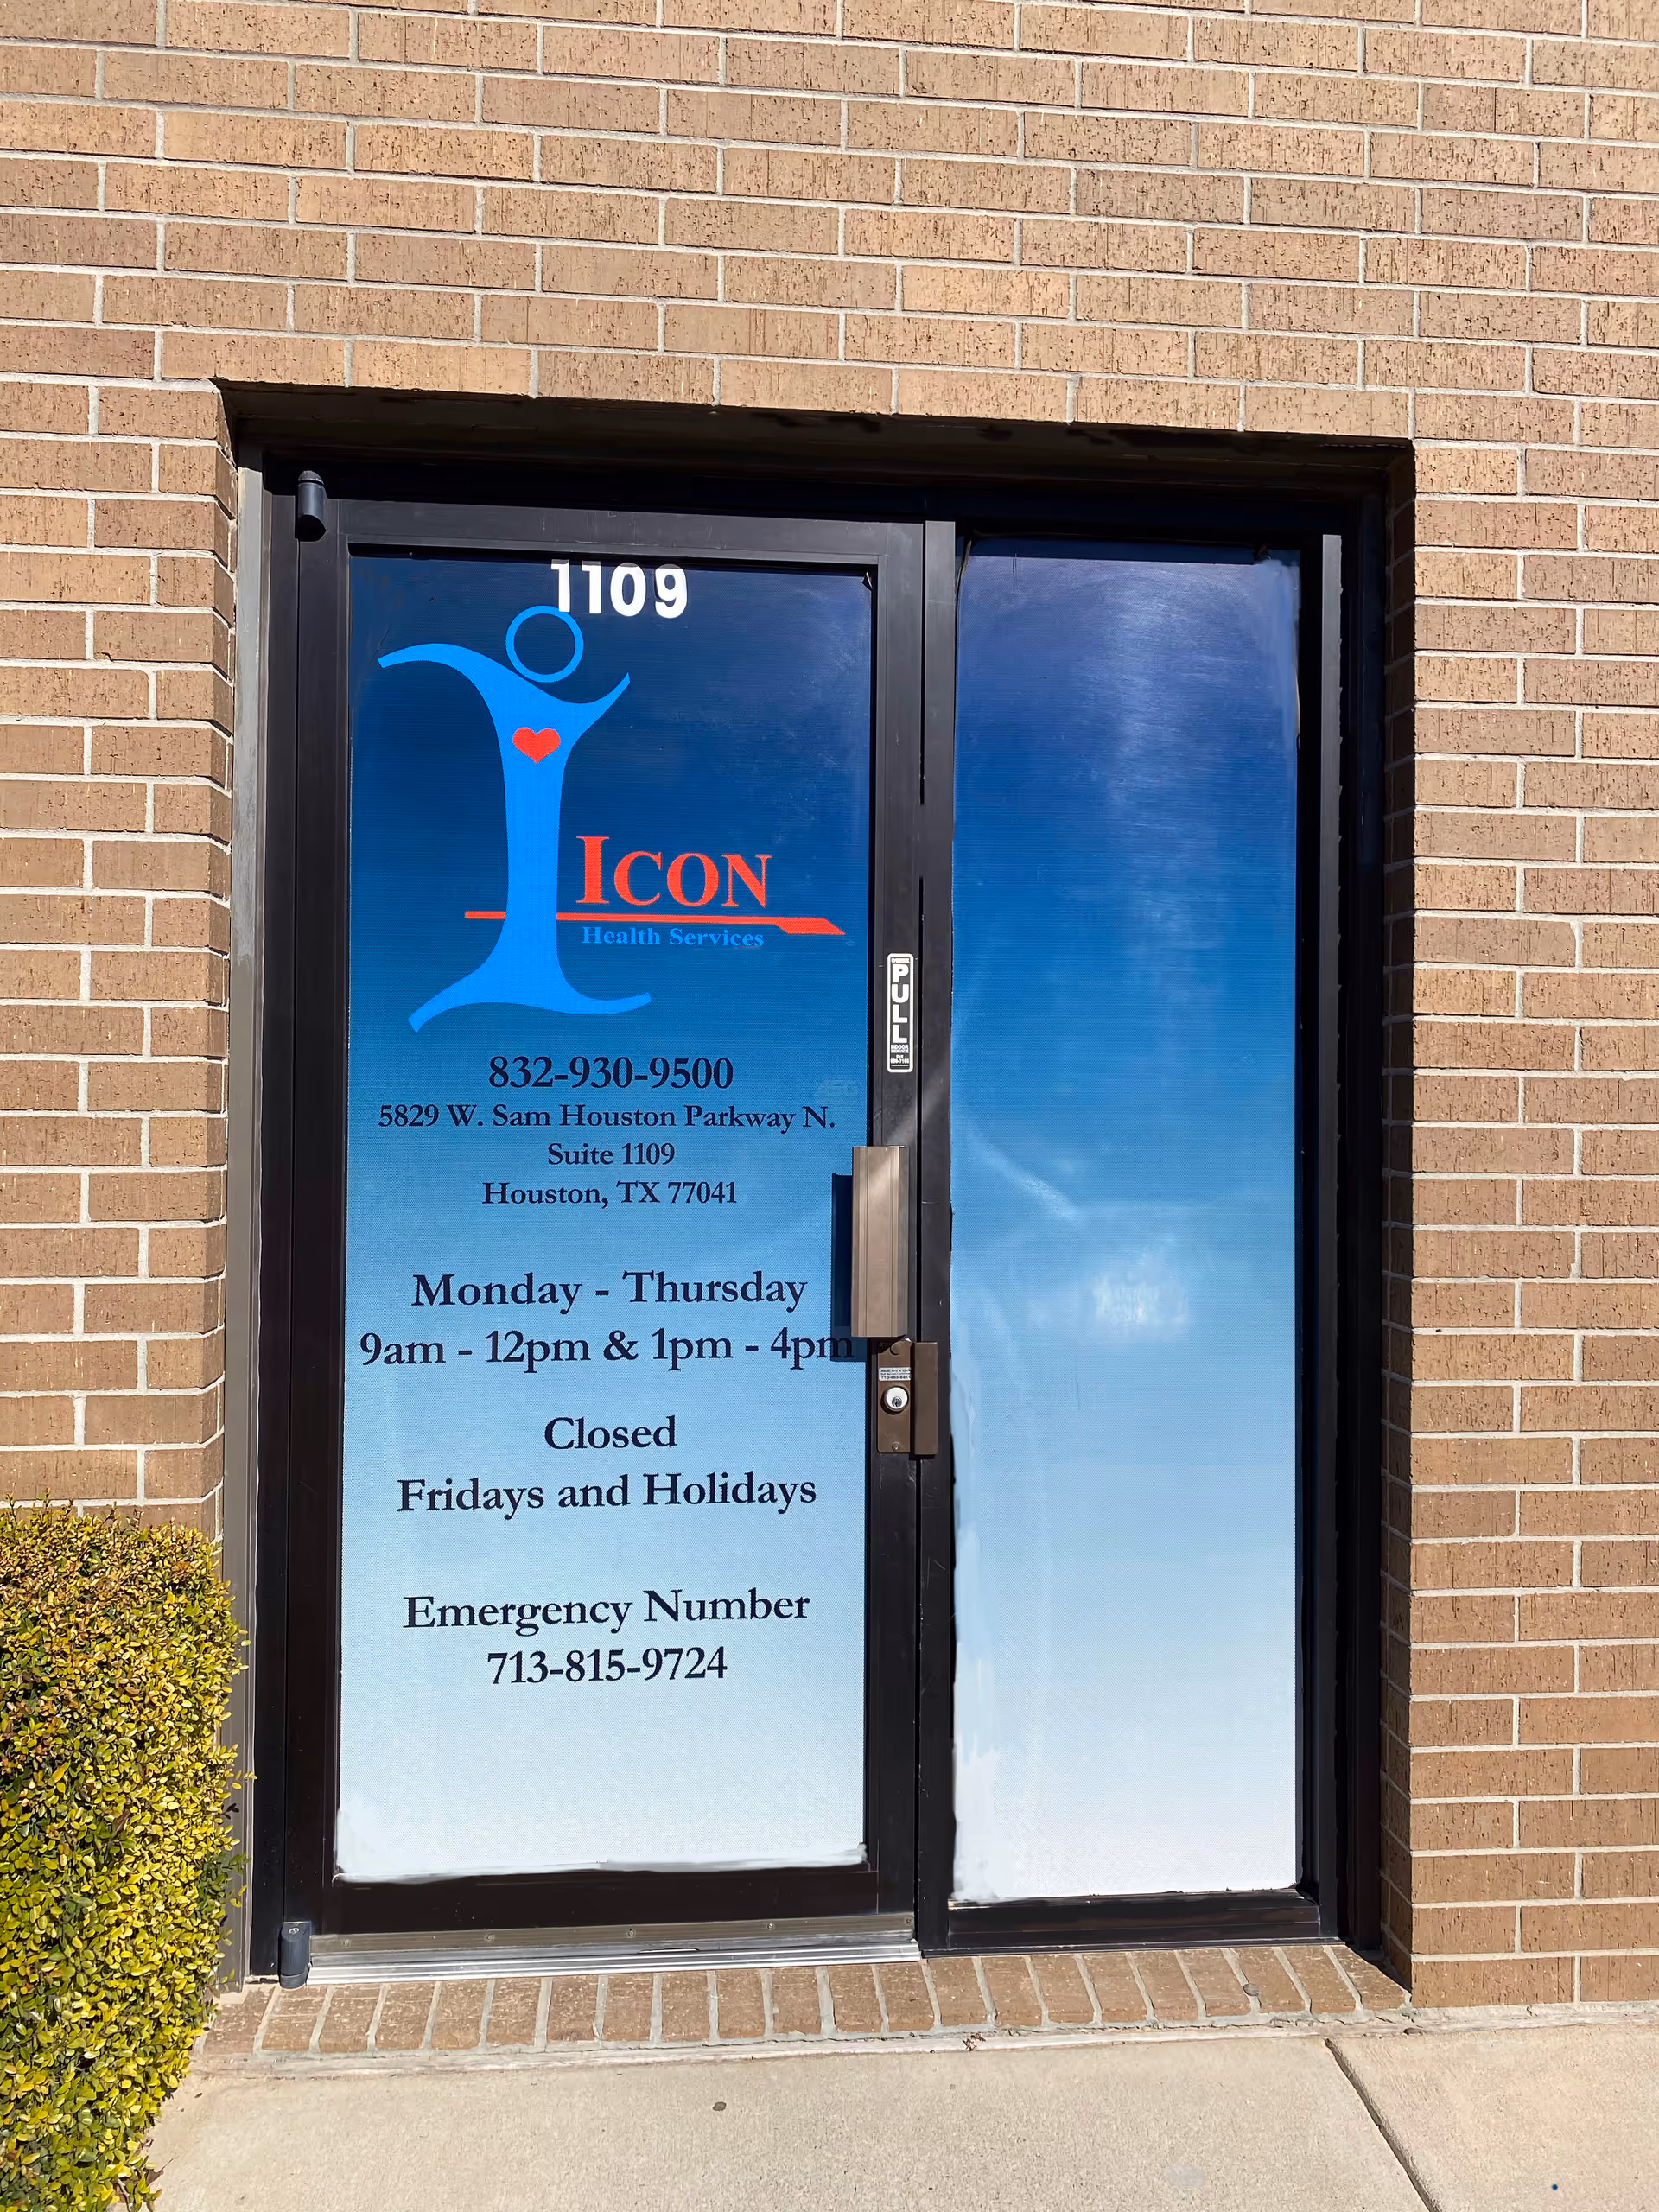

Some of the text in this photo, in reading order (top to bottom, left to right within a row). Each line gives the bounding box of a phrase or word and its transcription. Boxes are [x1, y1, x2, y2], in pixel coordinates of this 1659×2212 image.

[550, 559, 688, 619] 1109
[582, 926, 765, 947] Health Services
[891, 963, 910, 1044] PULL
[489, 1056, 734, 1089] 832-930-9500
[378, 1103, 835, 1134] 5829 W. Sam Houston Parkway N.
[548, 1142, 676, 1165] Suite 1109
[482, 1181, 737, 1209] Houston, TX 77041
[411, 1272, 583, 1314] Monday
[621, 1270, 809, 1313] Thursday
[359, 1332, 447, 1366] 9am
[485, 1331, 591, 1373] 12pm
[602, 1329, 639, 1362] &
[652, 1328, 734, 1371] 1pm
[770, 1326, 855, 1370] 4pm
[543, 1415, 678, 1450] Closed
[397, 1471, 817, 1521] Fridays and Holidays
[403, 1587, 811, 1637] Emergency Number
[486, 1645, 728, 1685] 713-815-9724
